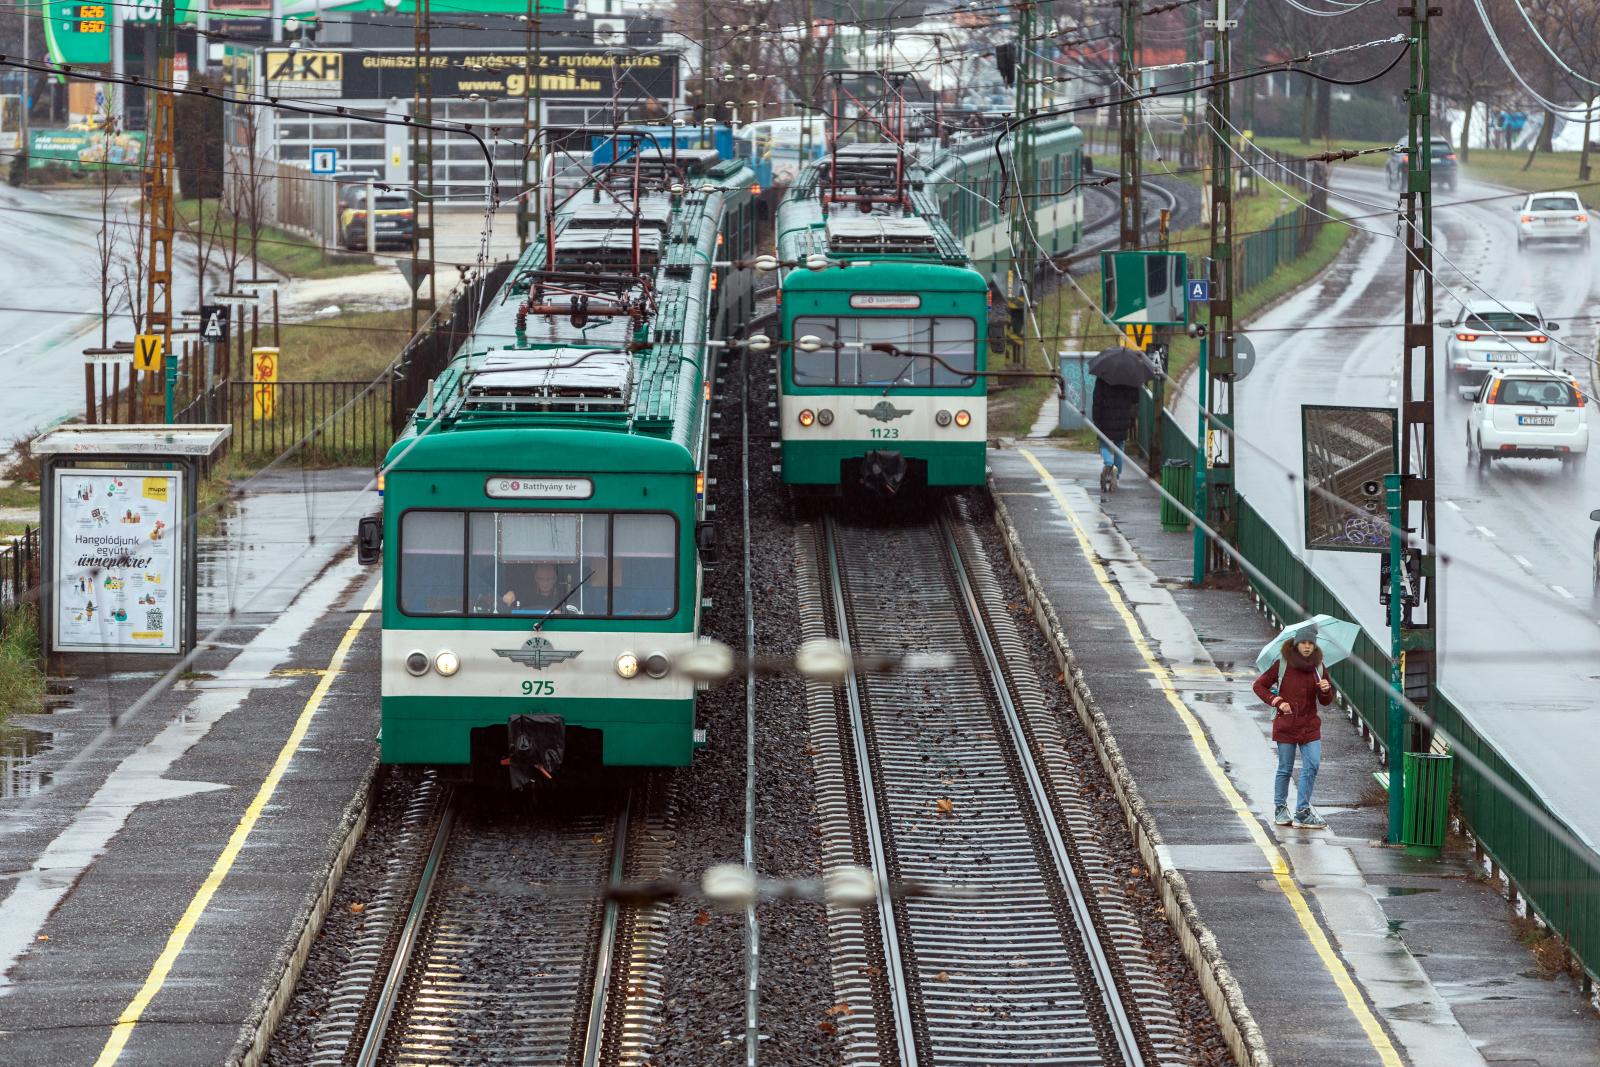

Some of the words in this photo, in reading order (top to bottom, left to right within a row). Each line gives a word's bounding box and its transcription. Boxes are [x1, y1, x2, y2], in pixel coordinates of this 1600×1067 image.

[80, 6, 105, 18] 626
[80, 21, 105, 33] 690
[1193, 283, 1203, 295] A
[1131, 324, 1147, 347] V
[141, 338, 157, 366] V
[870, 428, 899, 438] 1123
[523, 482, 563, 491] Batthyány
[565, 482, 576, 490] tér
[75, 534, 140, 546] Hangolódjunk
[96, 546, 129, 557] együtt
[77, 554, 152, 570] ünnepekre!
[521, 680, 555, 696] 975
